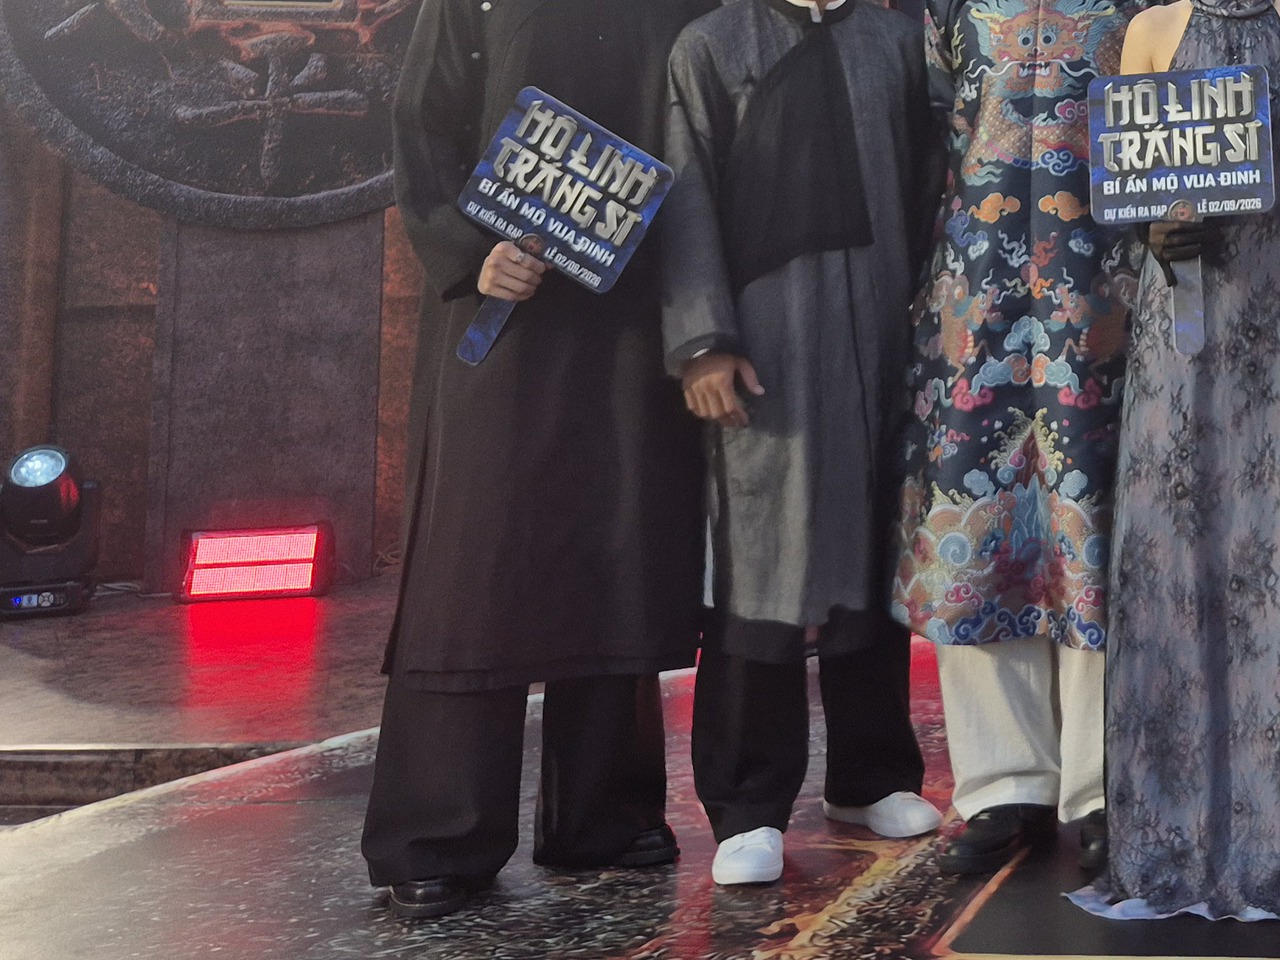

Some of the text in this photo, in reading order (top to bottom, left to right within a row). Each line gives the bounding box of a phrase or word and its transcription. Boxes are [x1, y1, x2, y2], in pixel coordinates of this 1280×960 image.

[1104, 72, 1255, 129] HỘ LINH
[516, 100, 658, 206] HỘ LINH
[1098, 124, 1220, 172] TRÁNG
[493, 138, 603, 228] TRÁNG
[1104, 170, 1260, 195] BÍ ẨN MỘ VUA ĐINH
[466, 201, 480, 216] DỰ
[495, 217, 508, 232] RA
[477, 178, 501, 196] BÍ
[519, 202, 546, 226] MỘ
[548, 218, 580, 249] VUA
[573, 235, 615, 267] ĐINH
[1104, 208, 1117, 221] DỰ
[1138, 206, 1150, 217] RA
[1151, 205, 1167, 217] RẠP
[1209, 198, 1261, 213] 02/09/2026
